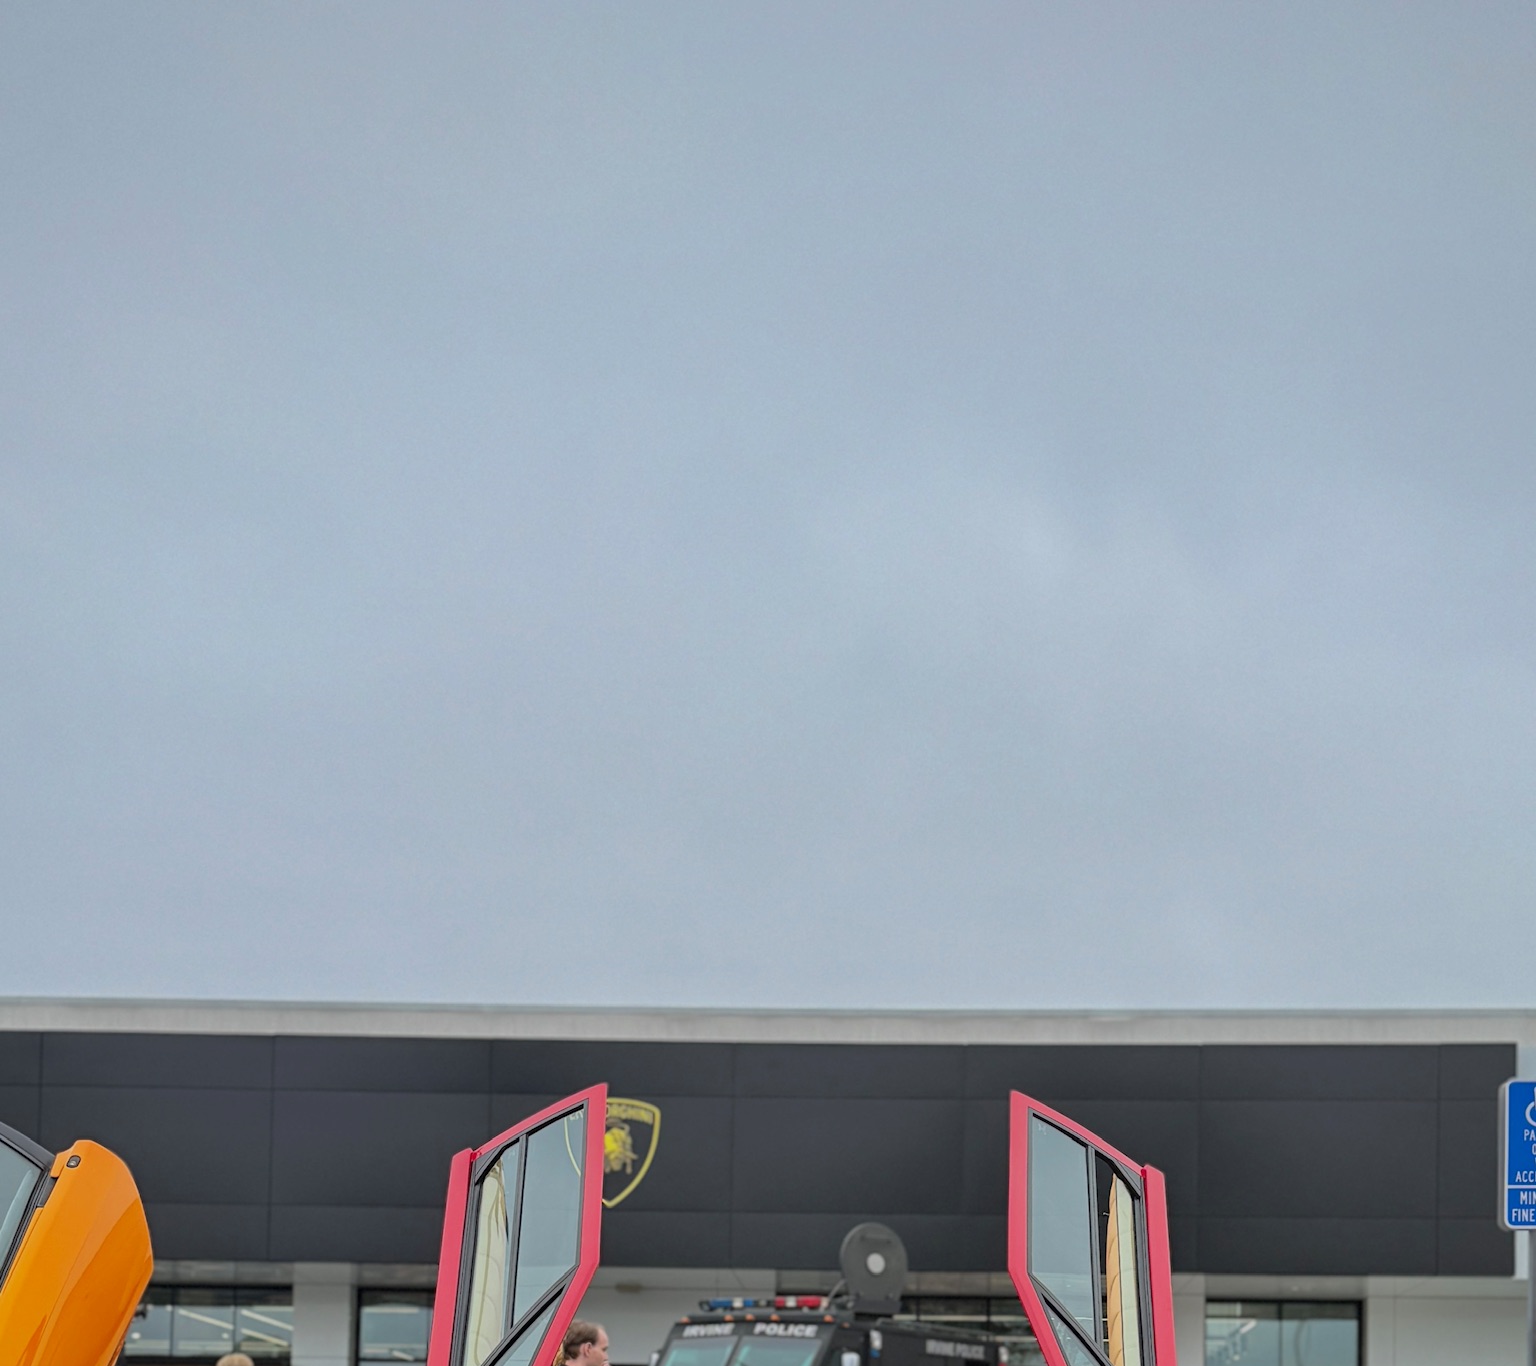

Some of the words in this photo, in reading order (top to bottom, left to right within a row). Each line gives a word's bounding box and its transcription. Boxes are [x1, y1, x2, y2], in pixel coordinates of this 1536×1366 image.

[1515, 1171, 1536, 1182] ACC
[1512, 1209, 1535, 1222] FINE
[683, 1323, 735, 1338] IRVINE
[753, 1322, 819, 1338] POLICE
